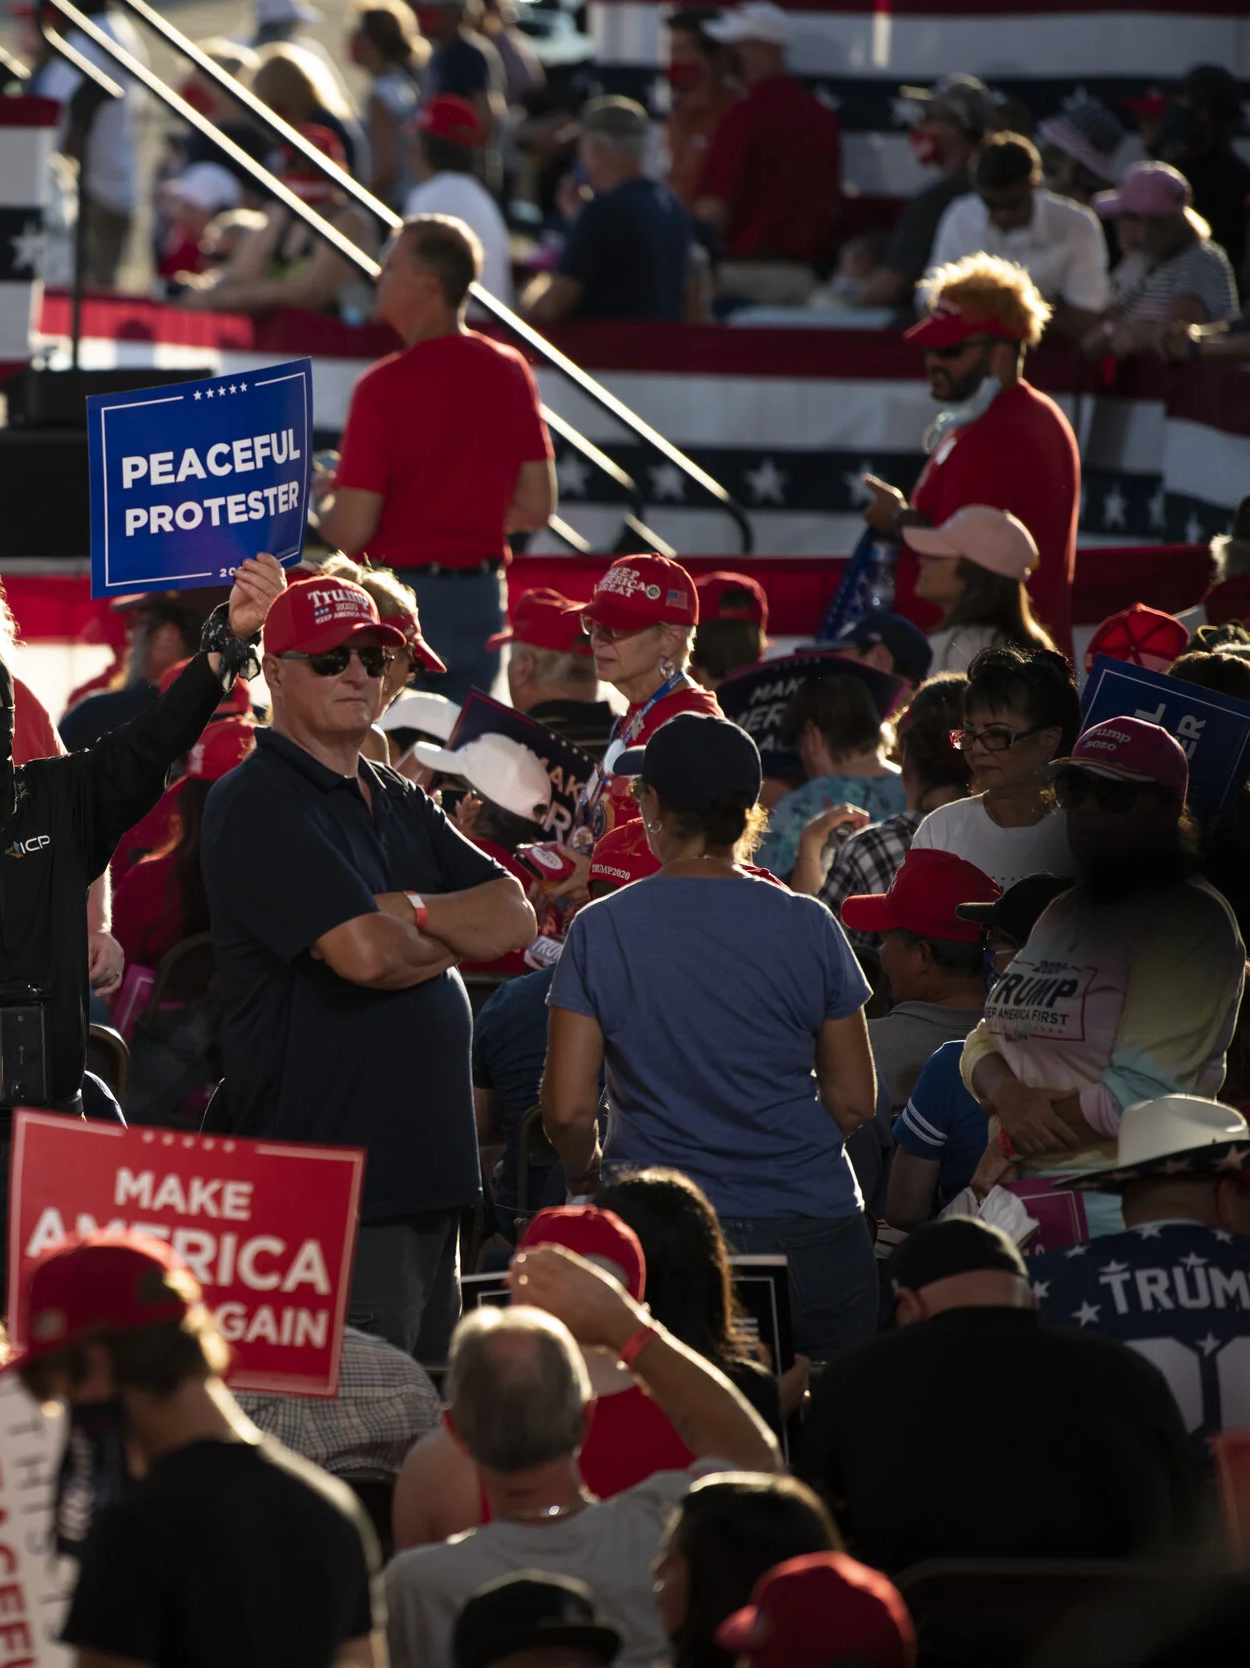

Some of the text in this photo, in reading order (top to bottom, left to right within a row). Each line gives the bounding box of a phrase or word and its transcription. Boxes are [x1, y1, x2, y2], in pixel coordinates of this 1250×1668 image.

[122, 428, 301, 489] PEACEFUL
[125, 480, 300, 537] PROTESTER
[20, 835, 51, 854] ICP
[114, 1166, 255, 1222] MAKE
[213, 1300, 331, 1350] GAIN
